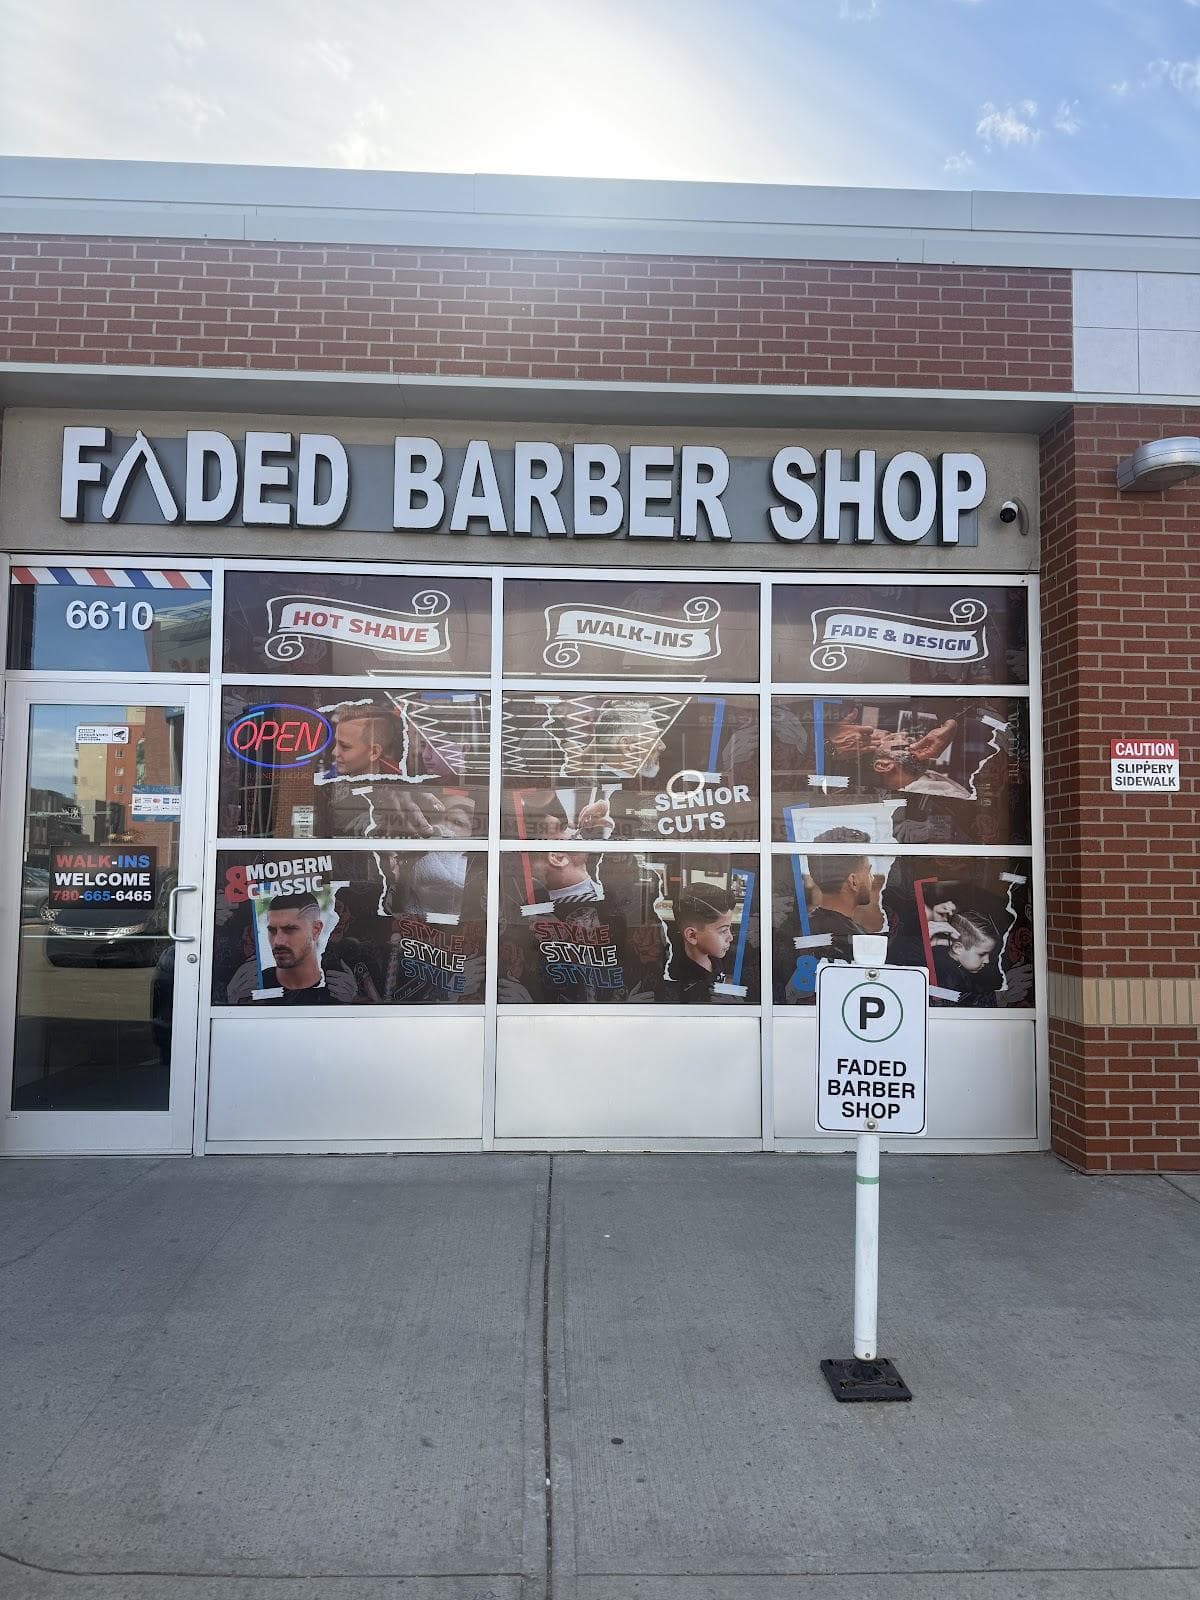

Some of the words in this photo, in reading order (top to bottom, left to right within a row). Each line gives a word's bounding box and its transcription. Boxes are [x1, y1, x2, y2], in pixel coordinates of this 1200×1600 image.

[60, 426, 349, 528] FADED
[393, 436, 732, 541] BARBER
[769, 446, 988, 545] SHOP
[65, 600, 154, 632] 6610
[293, 610, 343, 630] HOT
[349, 618, 428, 643] SHAVE
[576, 618, 694, 649] WALK-INS
[830, 623, 878, 642] FADE
[882, 628, 897, 643] &
[902, 632, 972, 652] DESIGN
[233, 720, 323, 753] OPEN
[1115, 742, 1175, 756] CAUTION
[1115, 776, 1176, 787] SIDEWALK
[1117, 763, 1173, 774] SLIPPERY
[655, 785, 751, 812] SENIOR
[657, 811, 726, 835] CUTS
[55, 854, 150, 868] WALK-INS
[245, 855, 332, 881] MODERN
[54, 872, 151, 886] WELCOME
[247, 875, 324, 901] CLASSIC
[52, 890, 152, 902] 780-665-6465
[399, 918, 464, 953] STYLE
[533, 920, 611, 945] STYLE
[400, 938, 467, 972] STYLE
[540, 941, 617, 967] STYLE
[401, 958, 466, 994] STYLE
[546, 963, 624, 989] STYLE
[859, 996, 885, 1030] P
[837, 1058, 907, 1077] FADED
[827, 1080, 916, 1100] BARBER
[841, 1101, 900, 1119] SHOP
